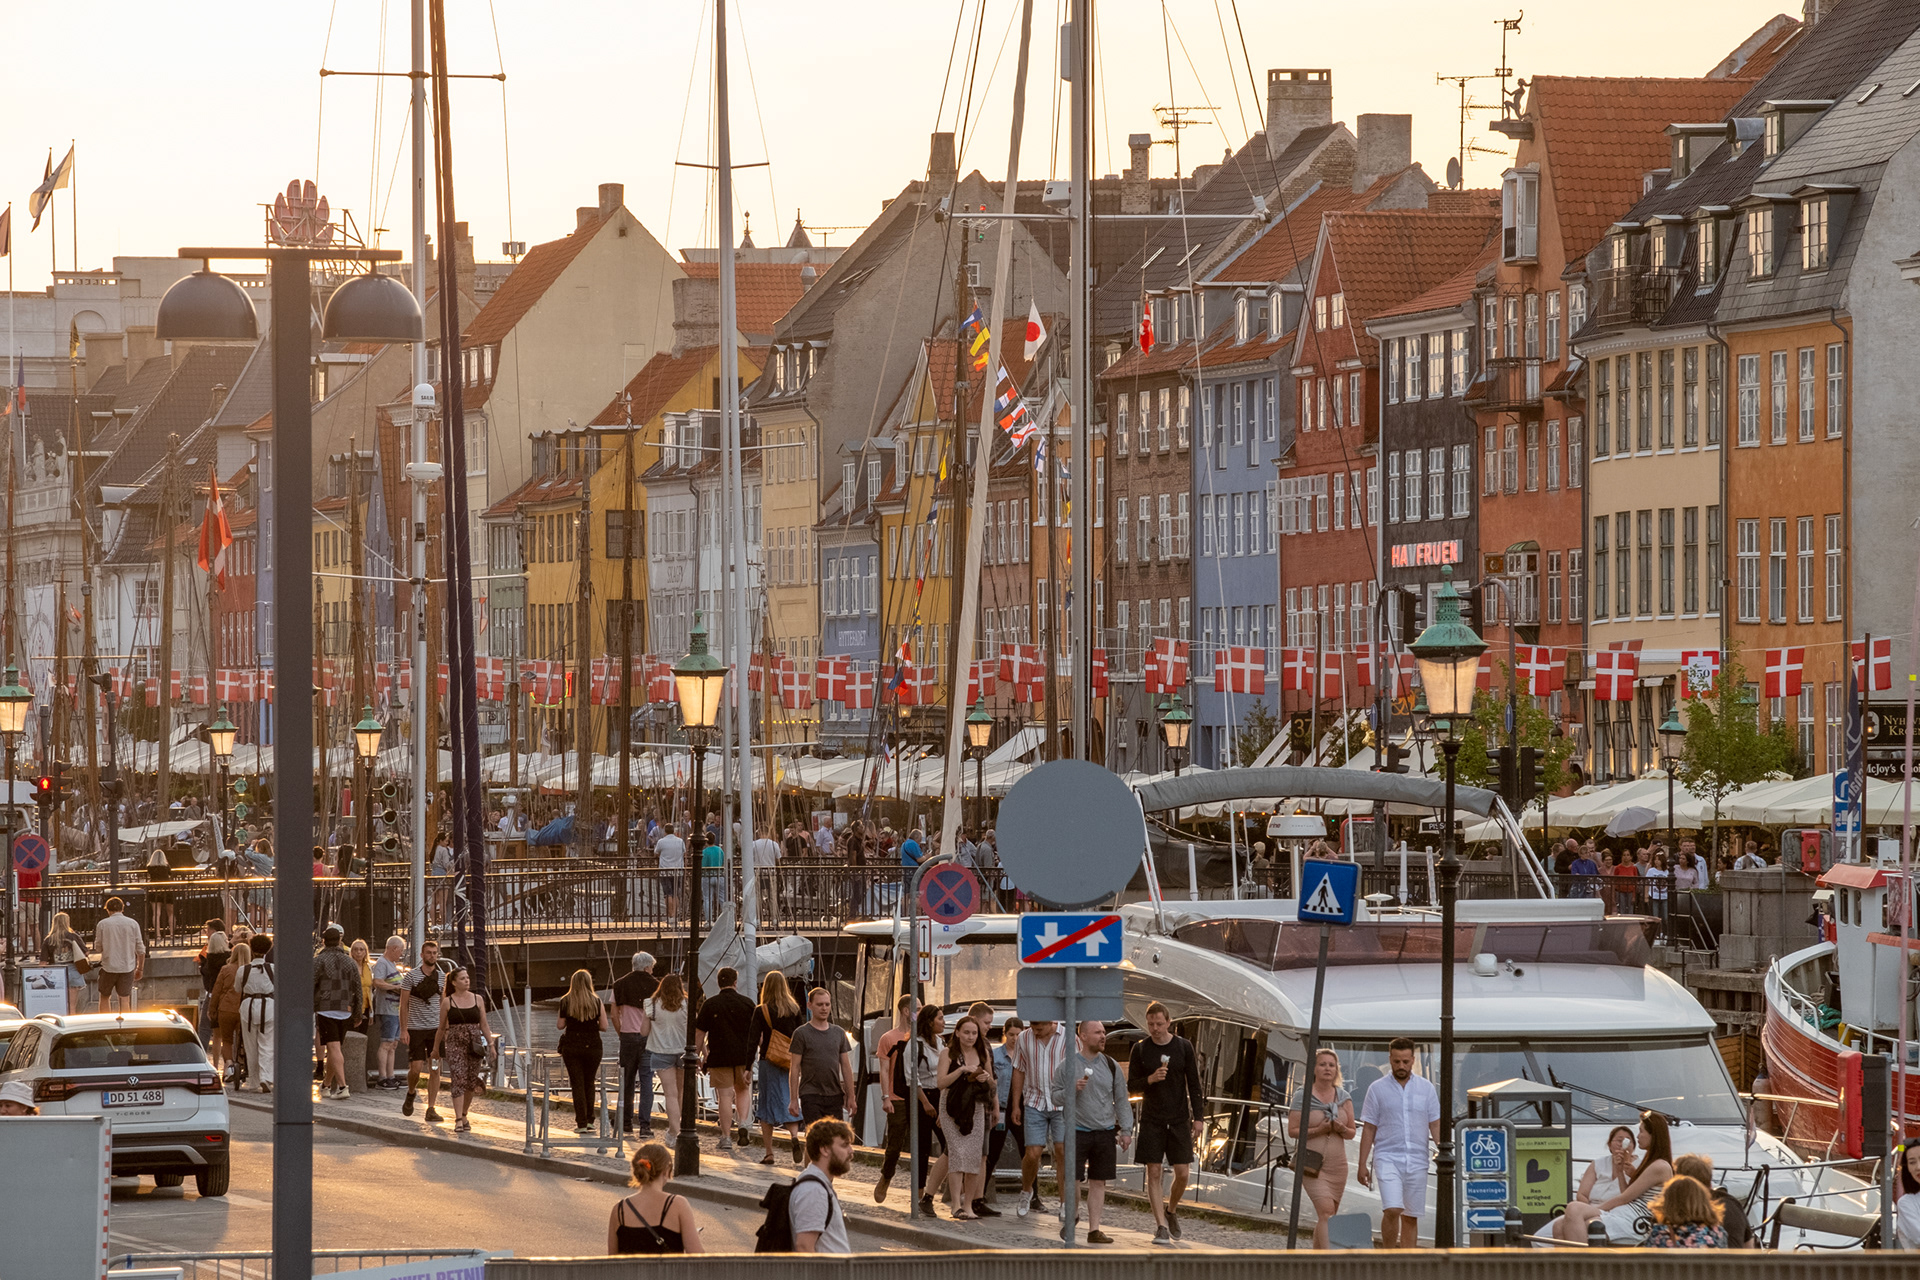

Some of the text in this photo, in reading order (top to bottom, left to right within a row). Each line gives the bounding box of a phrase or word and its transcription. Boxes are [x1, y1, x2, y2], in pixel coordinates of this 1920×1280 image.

[110, 1093, 125, 1103] DD
[127, 1092, 139, 1102] 51
[142, 1090, 162, 1101] 488
[1483, 1159, 1498, 1168] 101
